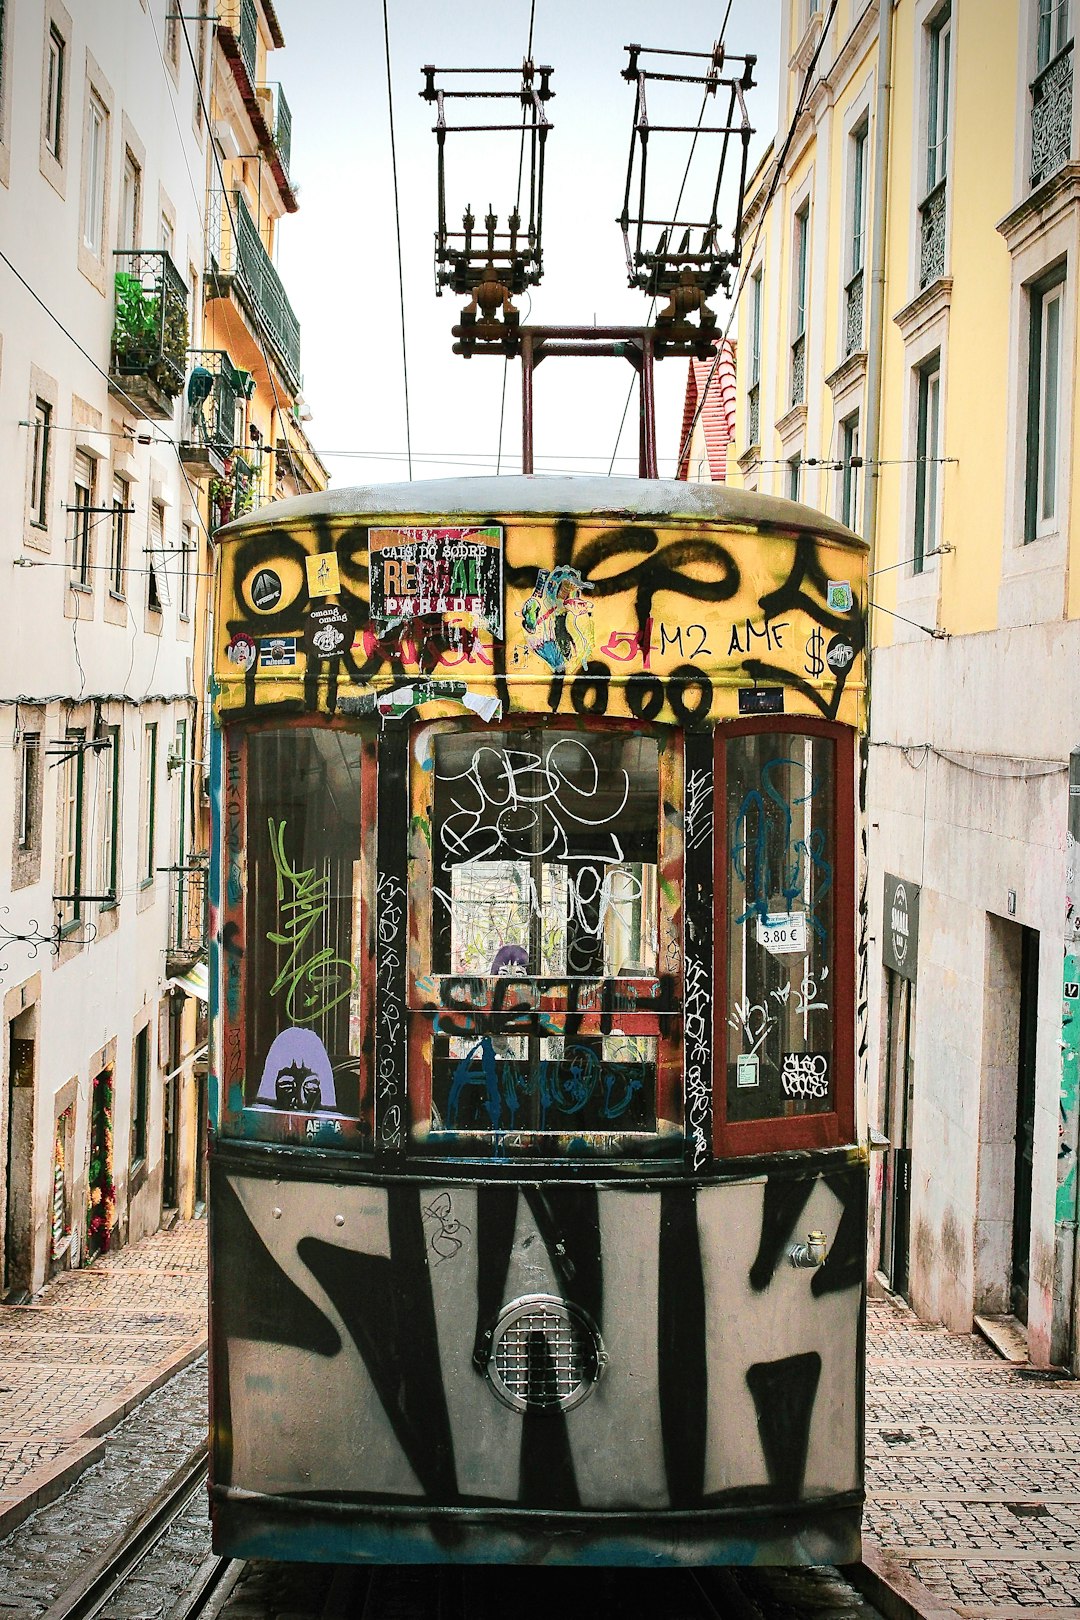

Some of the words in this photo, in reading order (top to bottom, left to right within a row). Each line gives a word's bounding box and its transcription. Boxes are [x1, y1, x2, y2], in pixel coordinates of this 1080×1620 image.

[382, 545, 414, 559] CAIS
[420, 545, 437, 557] DO
[383, 559, 485, 595] REGGAE
[310, 607, 340, 619] omang
[386, 598, 483, 615] PARADE
[318, 613, 348, 624] omang
[660, 622, 712, 660] M2
[763, 930, 787, 943] 3.80
[790, 929, 798, 941] €
